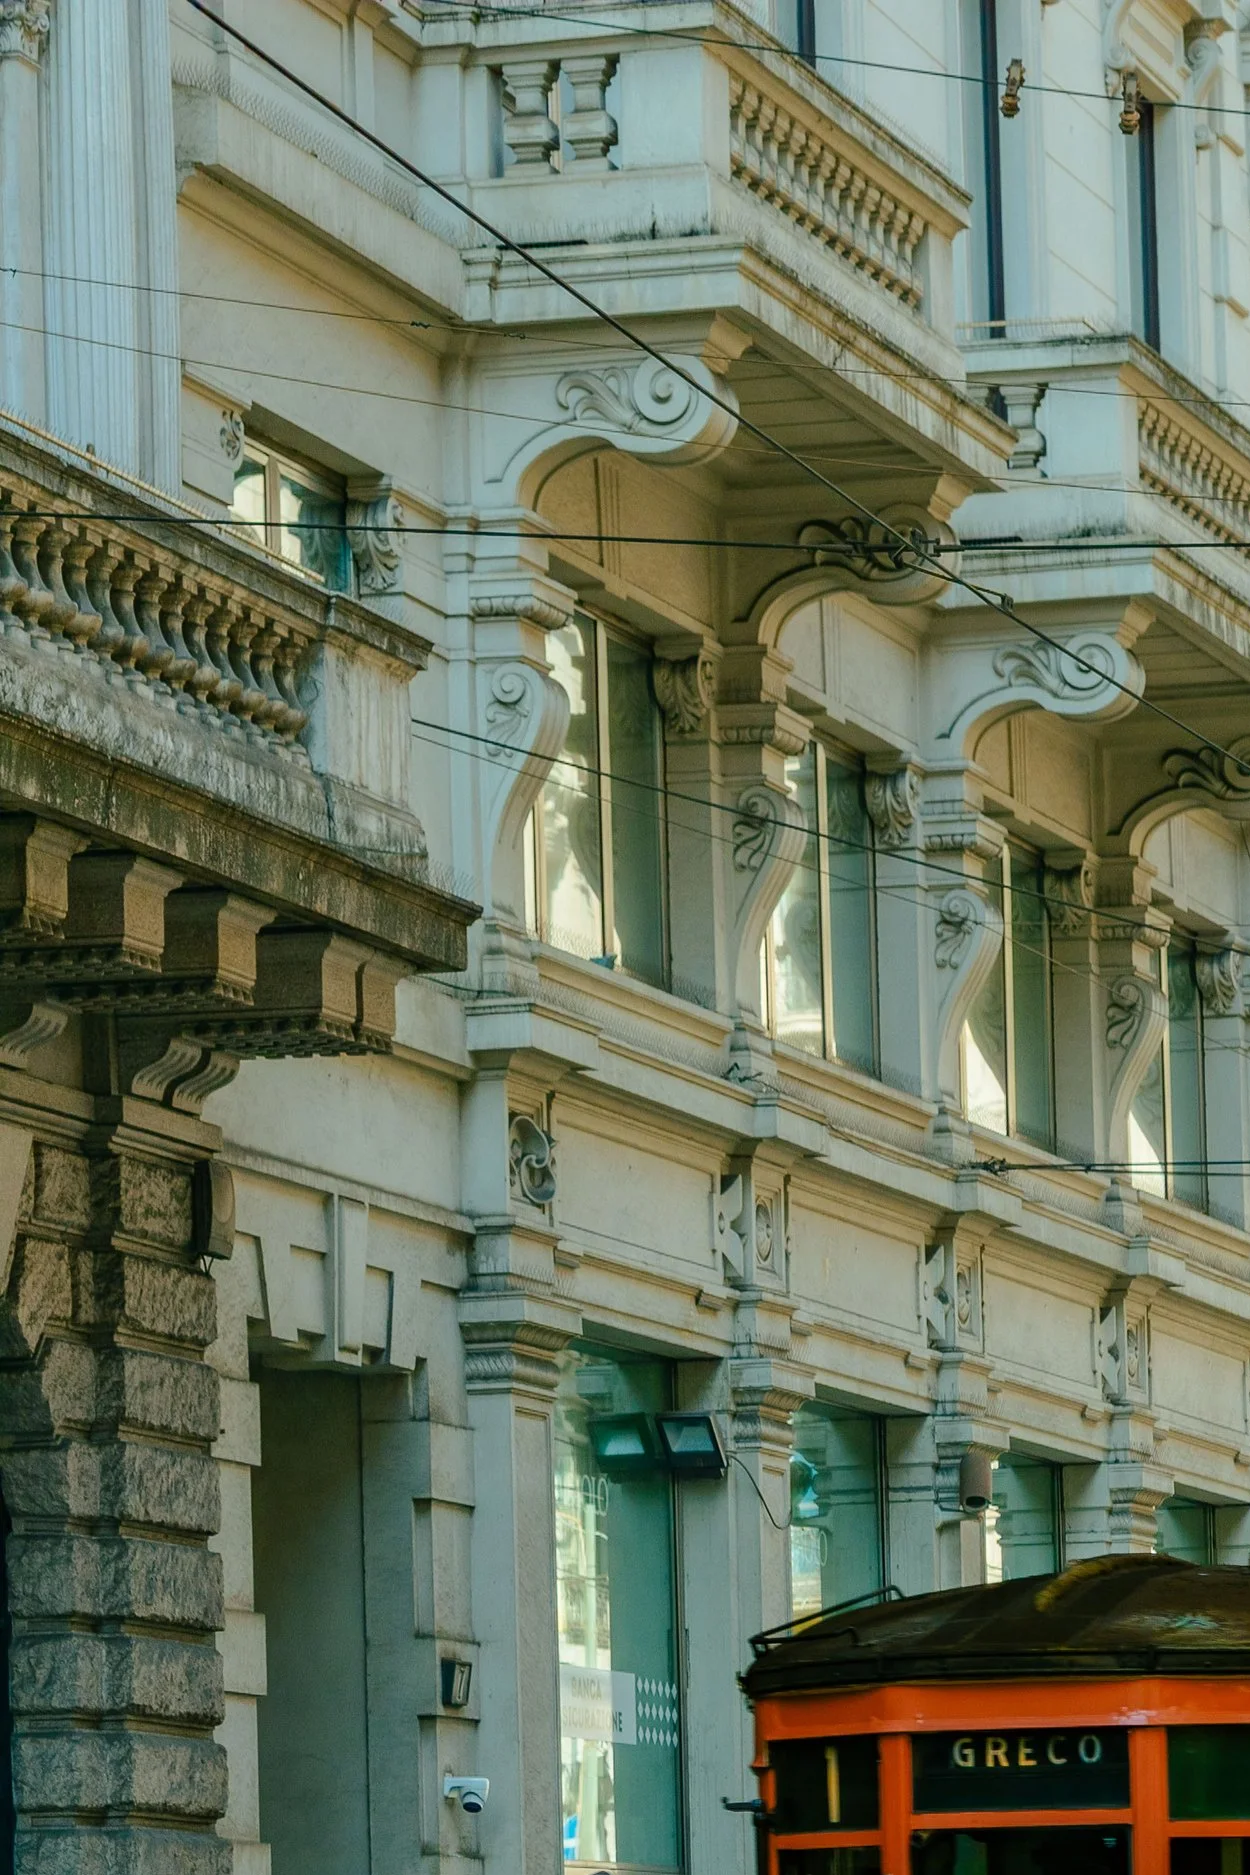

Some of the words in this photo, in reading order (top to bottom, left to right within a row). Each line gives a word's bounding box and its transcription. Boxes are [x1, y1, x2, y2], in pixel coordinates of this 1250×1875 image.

[562, 1704, 623, 1732] SICURAZIONE
[952, 1734, 1102, 1768] GRECO
[825, 1745, 841, 1823] 1
